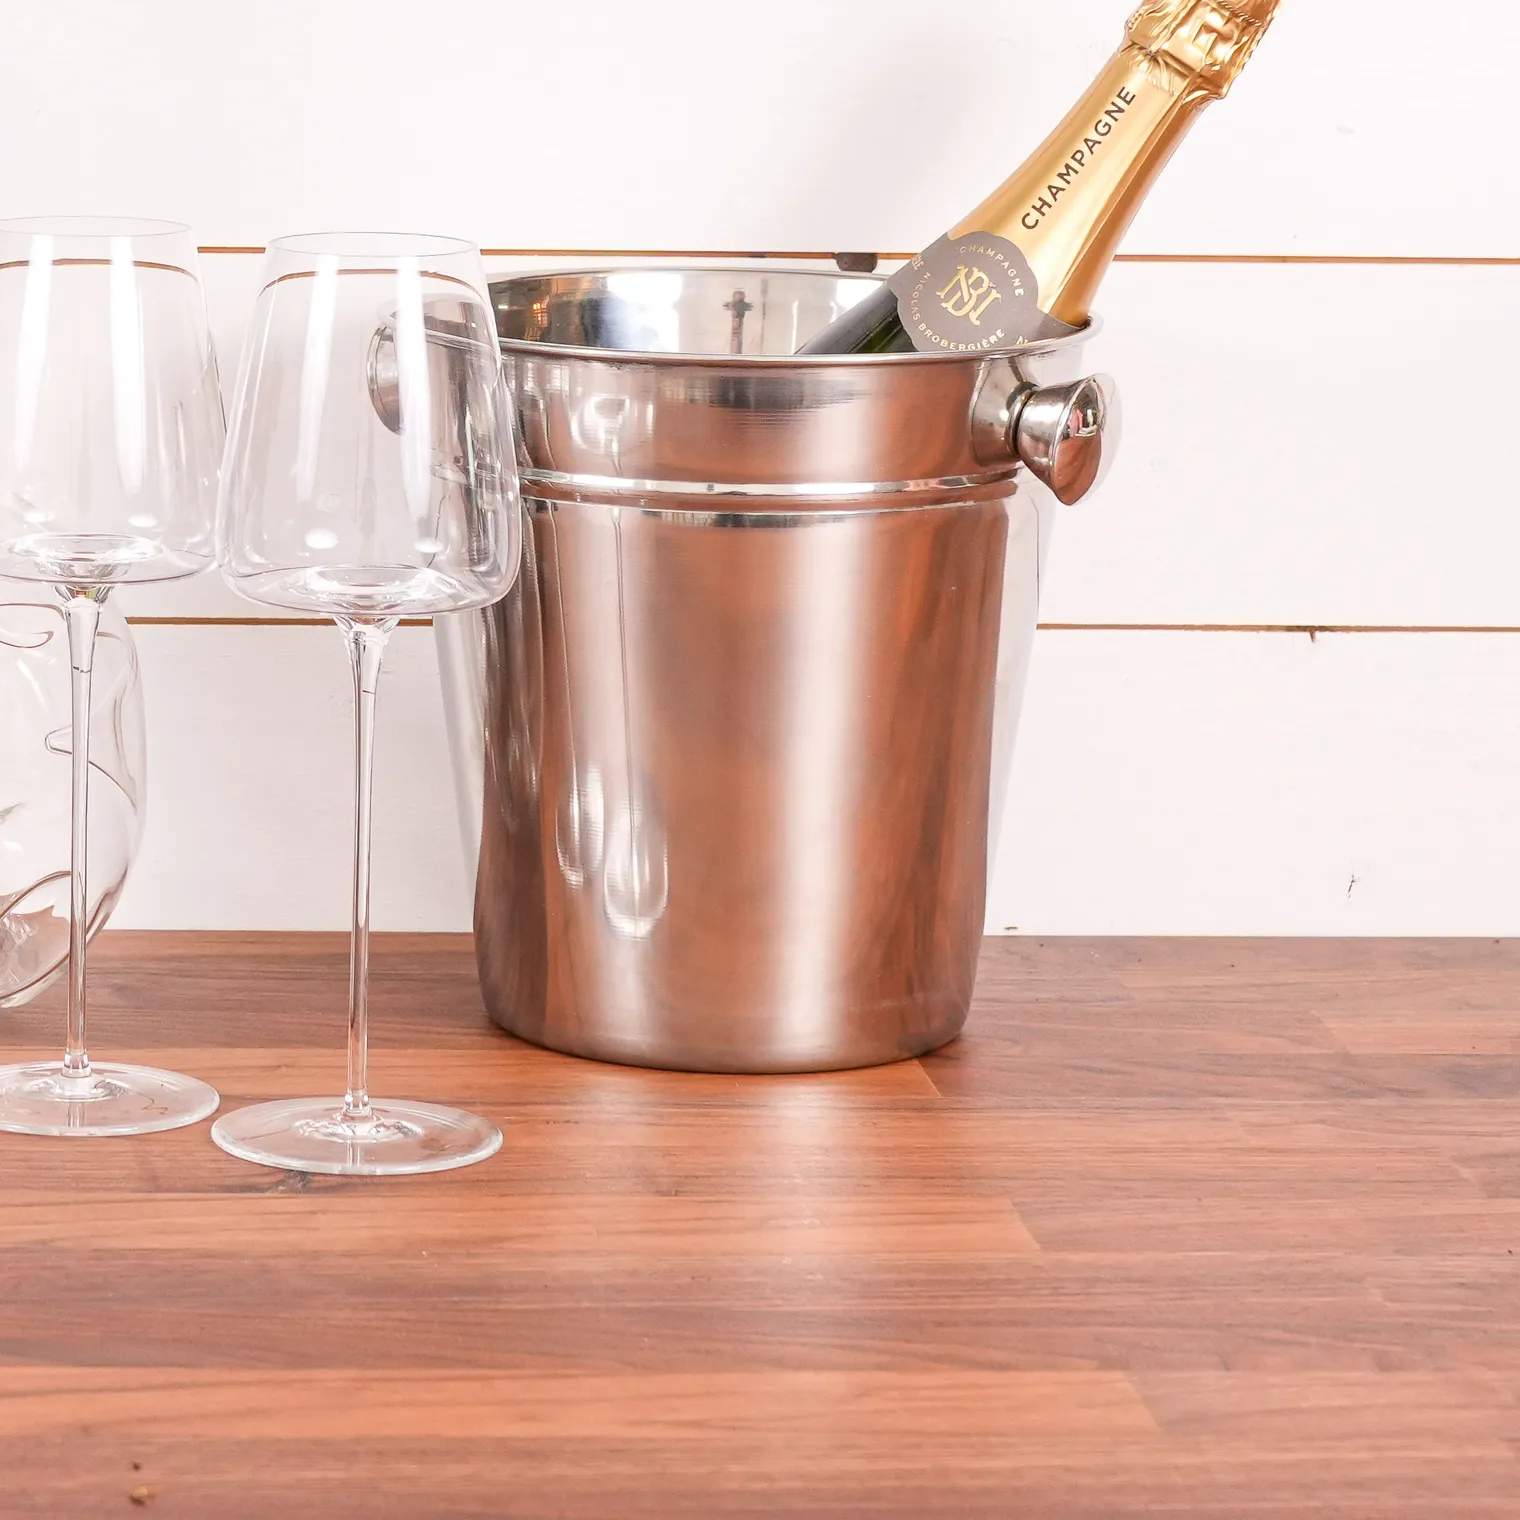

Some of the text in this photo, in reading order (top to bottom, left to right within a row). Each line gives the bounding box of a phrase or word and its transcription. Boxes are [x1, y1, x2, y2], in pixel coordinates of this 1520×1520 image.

[1020, 85, 1136, 231] CHAMPAGNE
[911, 272, 931, 321] NICOLAS
[959, 244, 1024, 297] CHAMPAGNE
